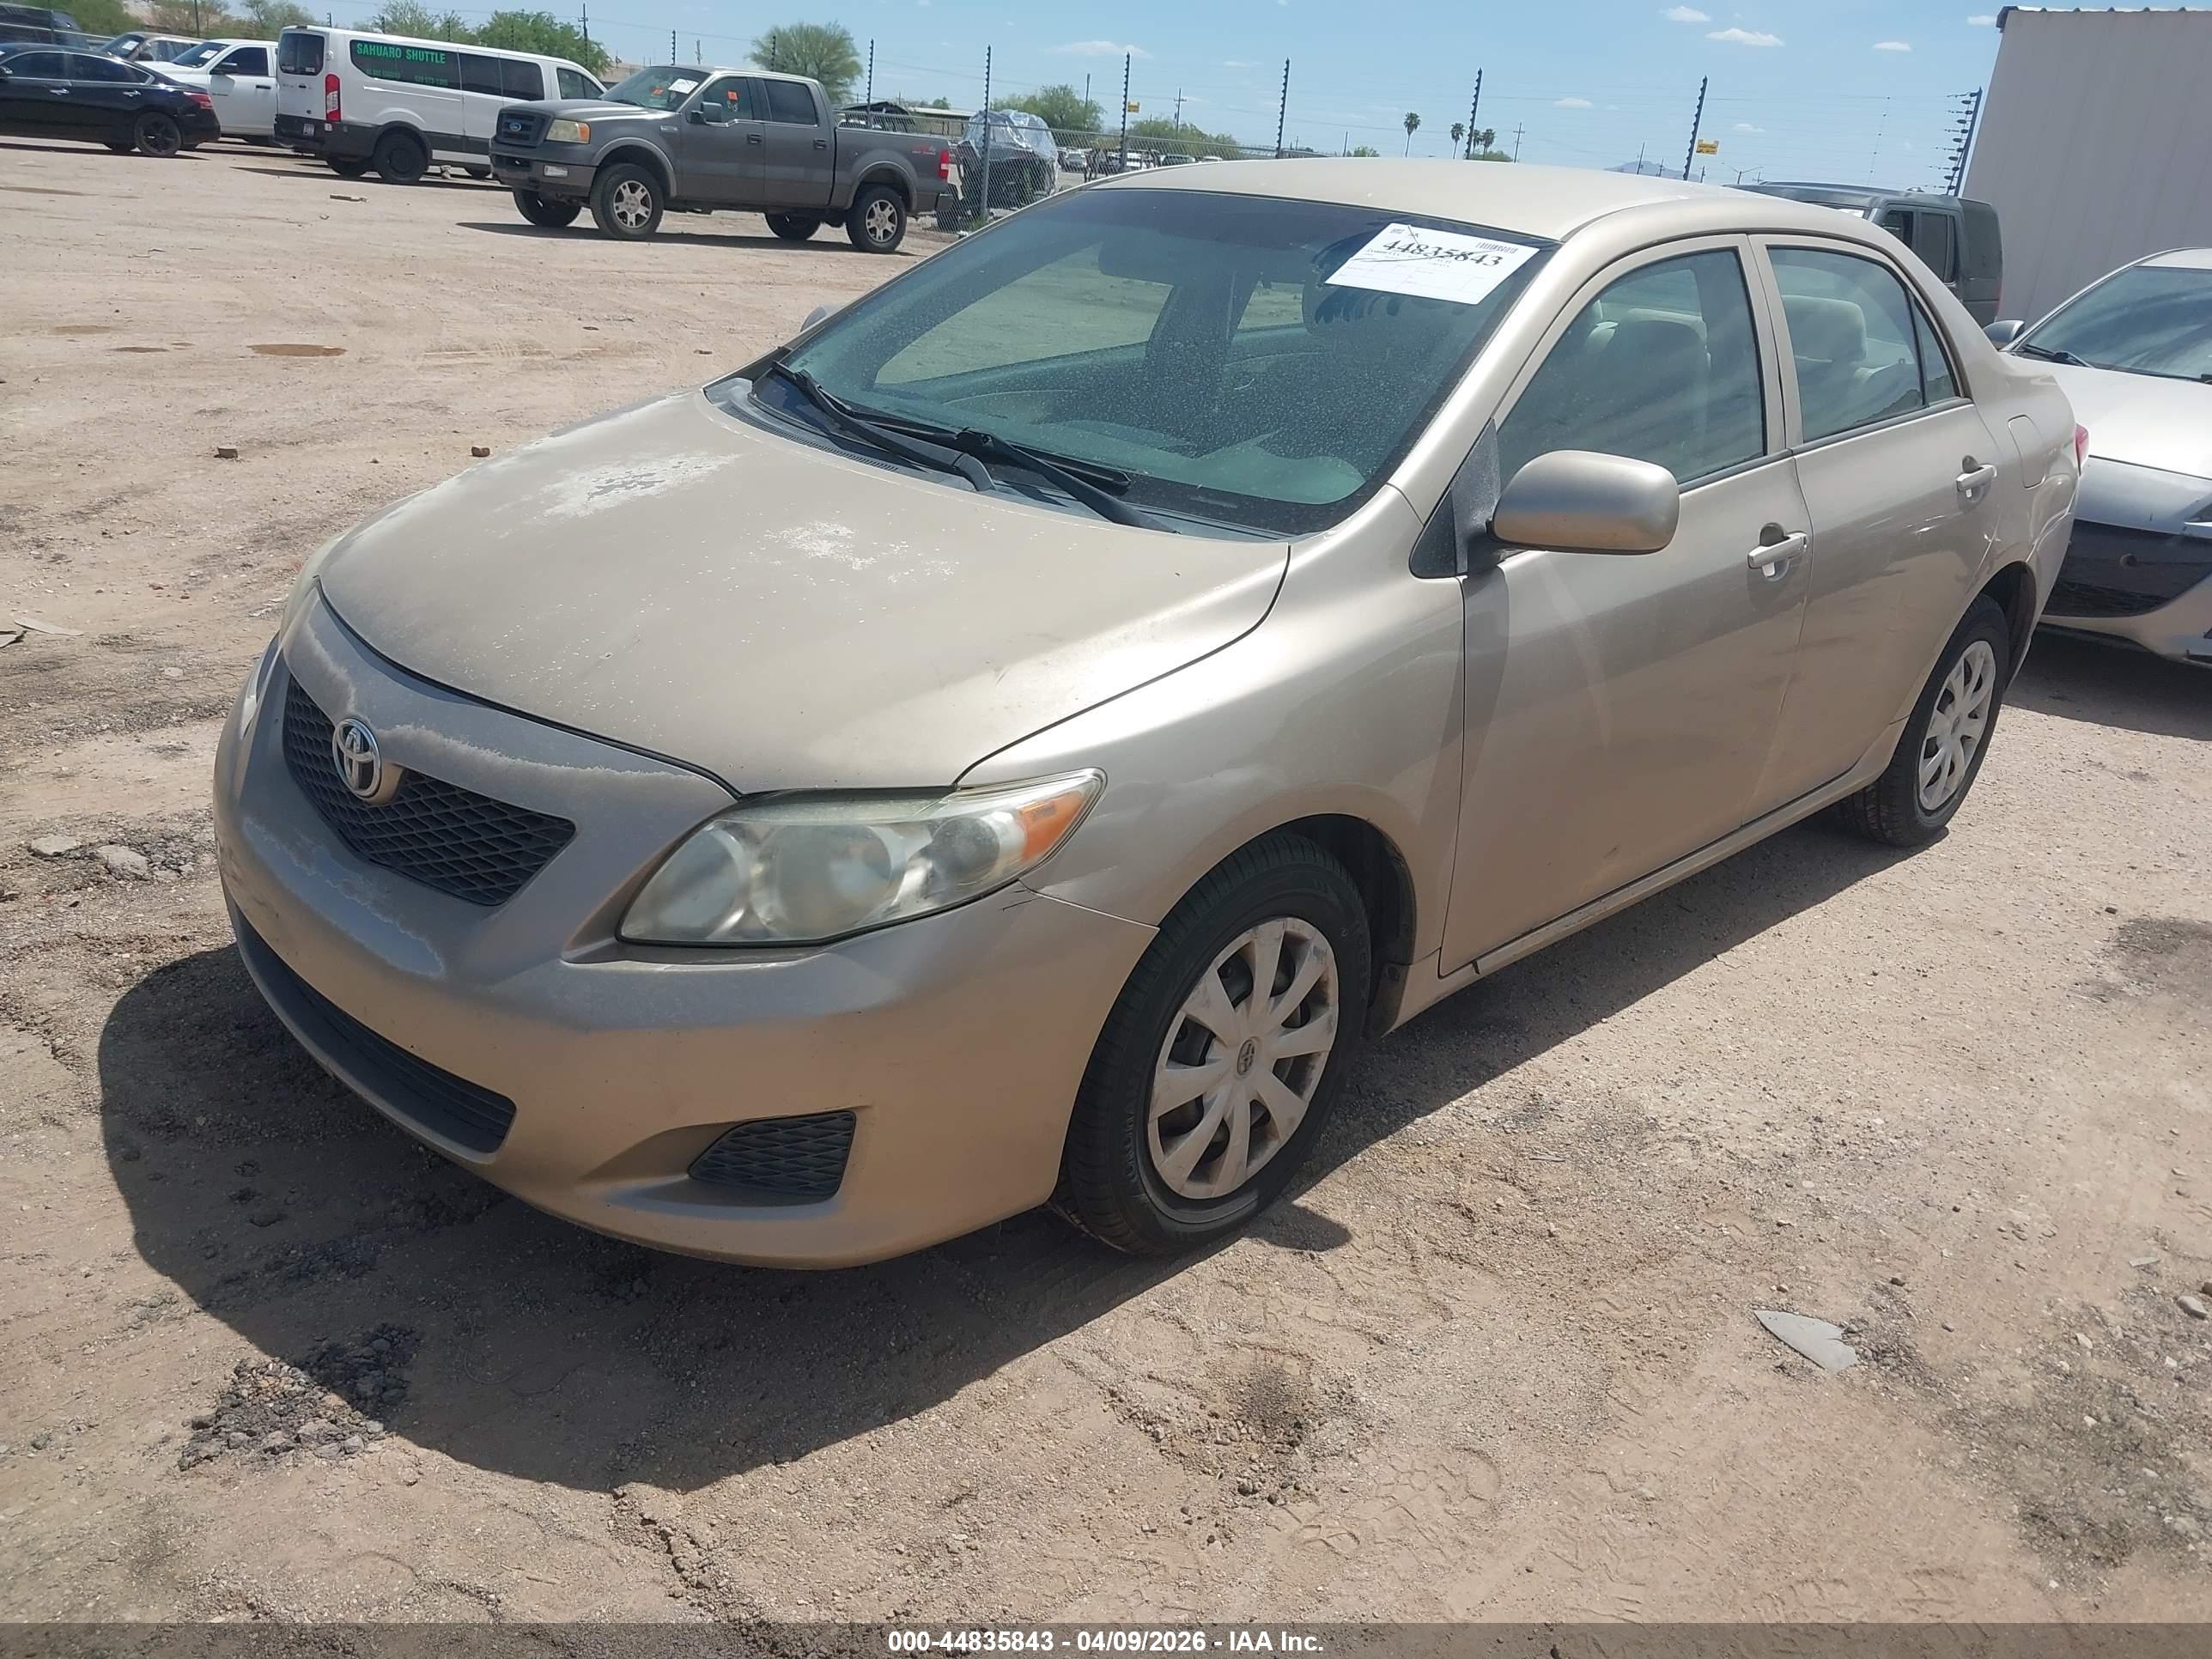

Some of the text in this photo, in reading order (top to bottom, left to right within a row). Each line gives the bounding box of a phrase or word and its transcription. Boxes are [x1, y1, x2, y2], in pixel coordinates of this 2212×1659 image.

[356, 43, 446, 64] SAHUARO SHUTTLE
[1382, 240, 1504, 267] 44835843
